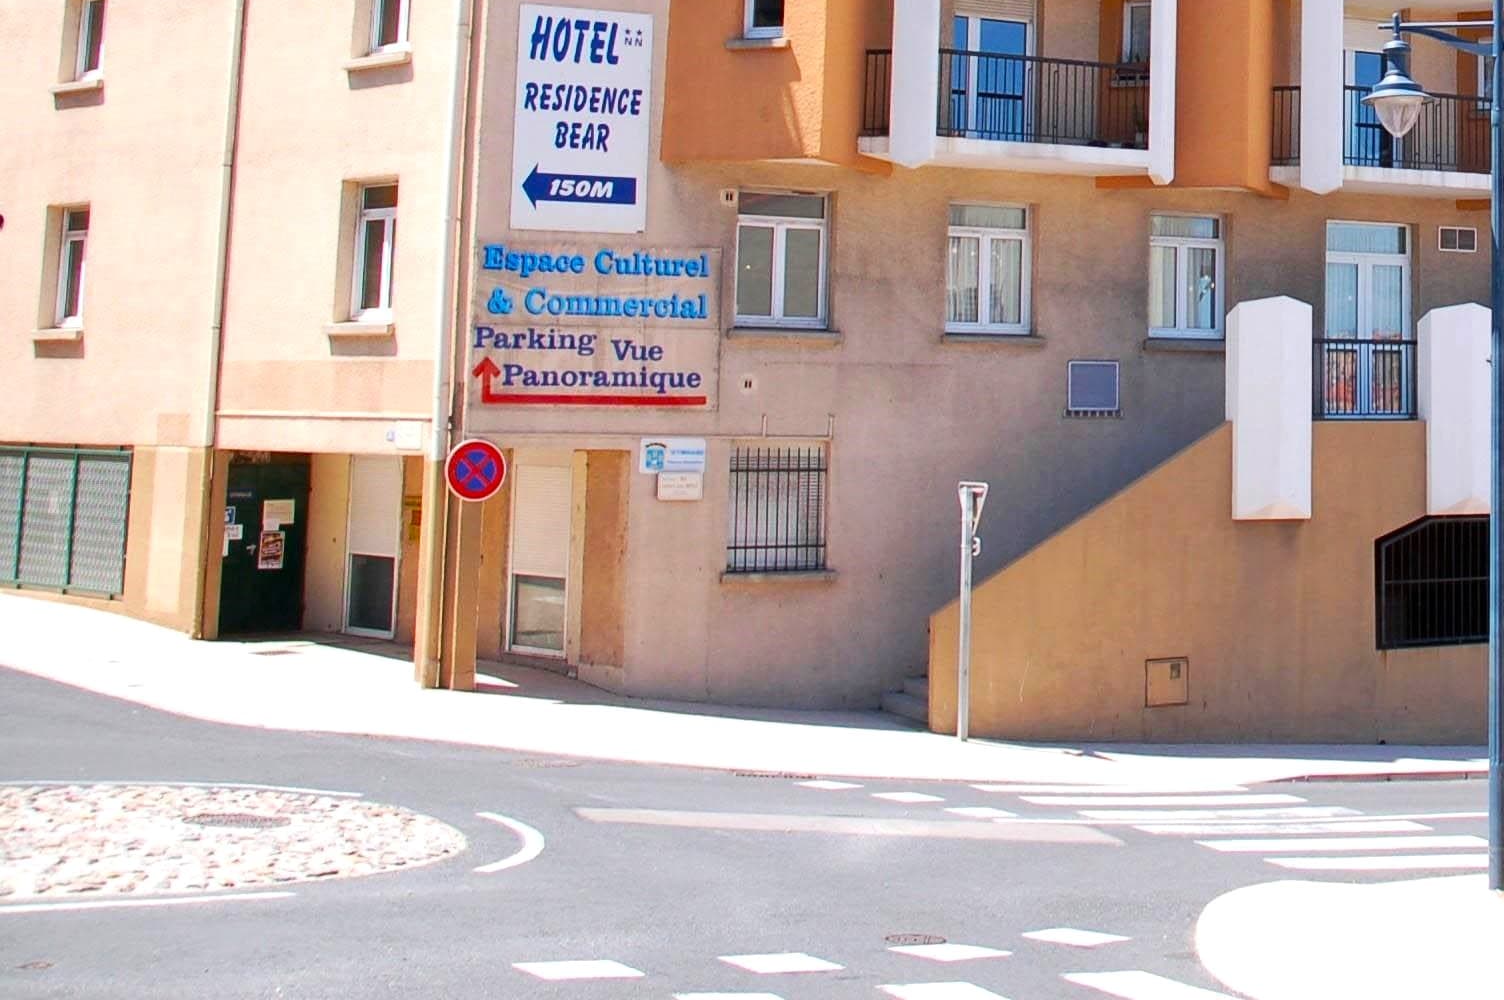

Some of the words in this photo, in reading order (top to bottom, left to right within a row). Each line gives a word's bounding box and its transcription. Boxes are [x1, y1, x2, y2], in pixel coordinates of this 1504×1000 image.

[529, 15, 619, 65] HOTEL
[524, 82, 643, 115] RESIDENCE
[554, 121, 610, 152] BEAR
[550, 179, 614, 199] 150M
[483, 244, 585, 278] Espace
[594, 249, 709, 277] Culturel
[487, 287, 513, 315] &
[525, 287, 708, 319] Commercial
[473, 326, 597, 355] Parking
[611, 339, 663, 361] Vue
[502, 364, 701, 394] Panoramique
